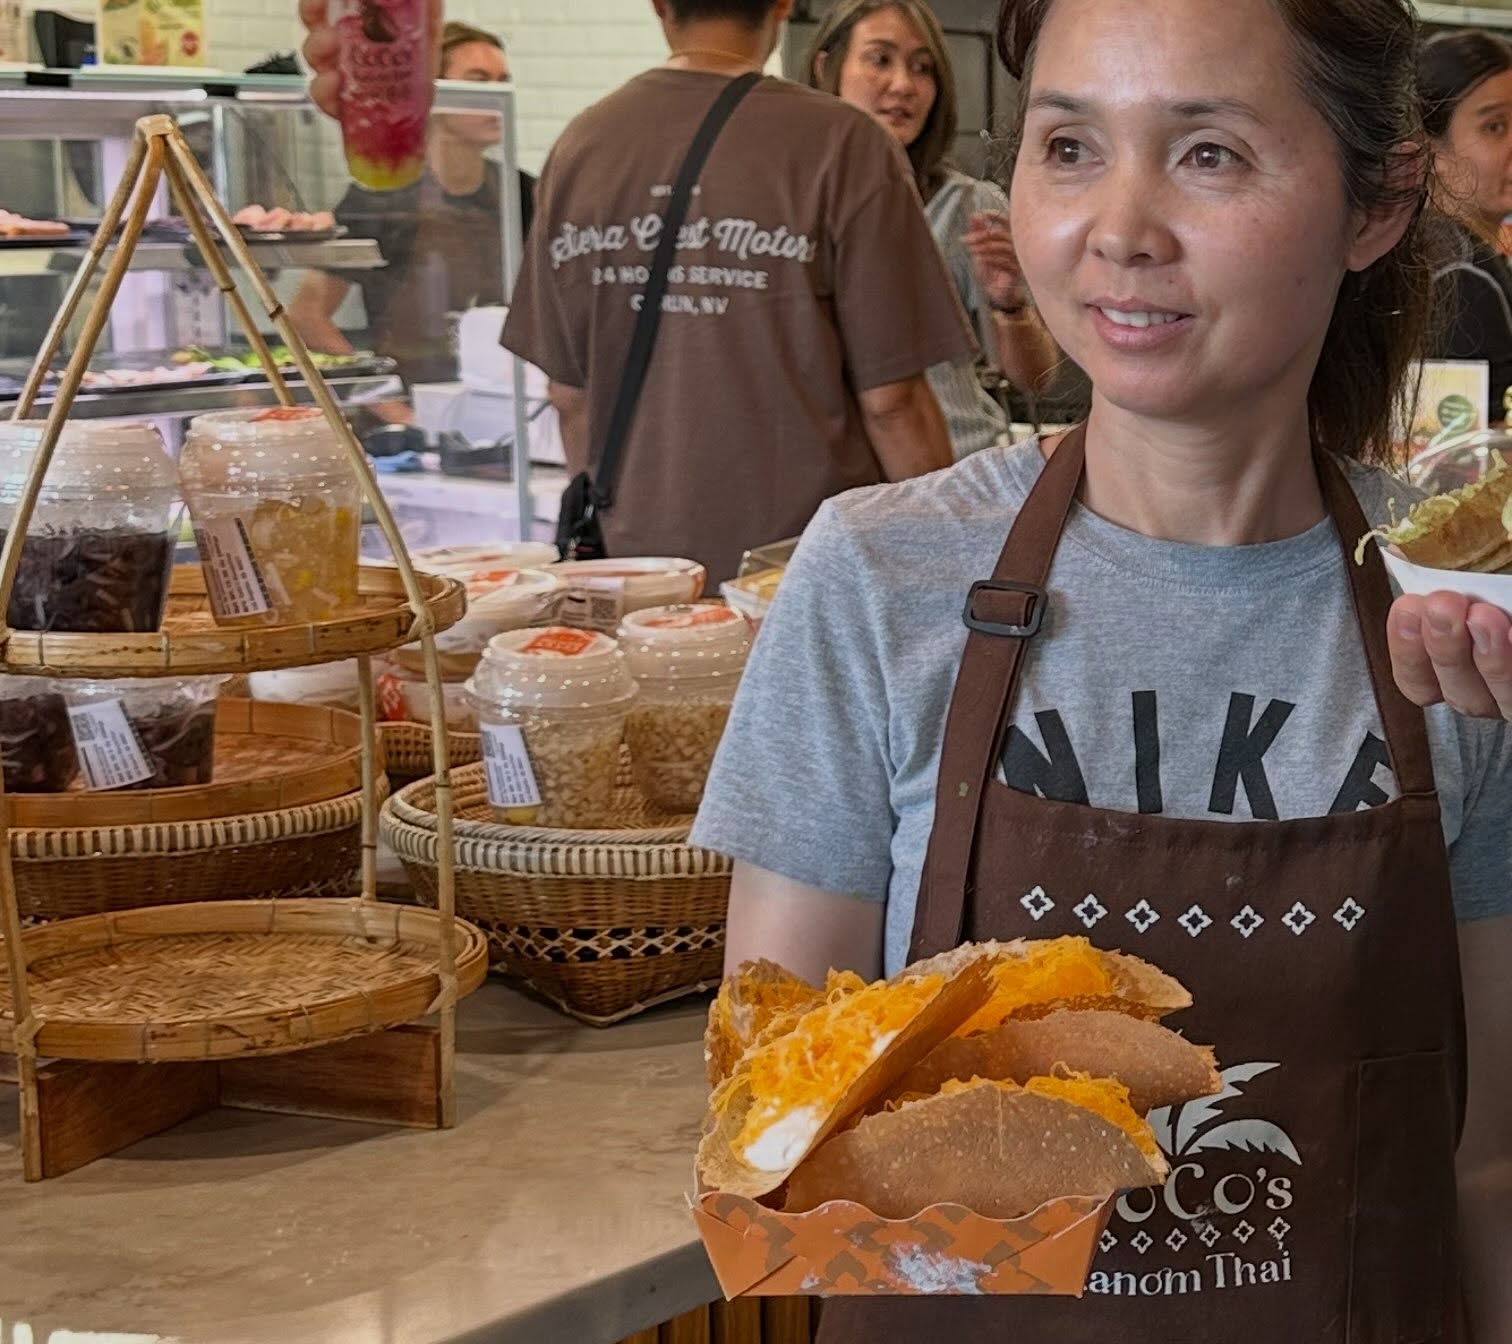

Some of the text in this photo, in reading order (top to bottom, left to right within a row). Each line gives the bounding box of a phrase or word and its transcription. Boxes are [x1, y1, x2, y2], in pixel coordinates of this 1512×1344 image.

[687, 265, 769, 290] SERVICE
[1116, 1162, 1294, 1223] oCo's
[1085, 1242, 1293, 1297] anom Thai
